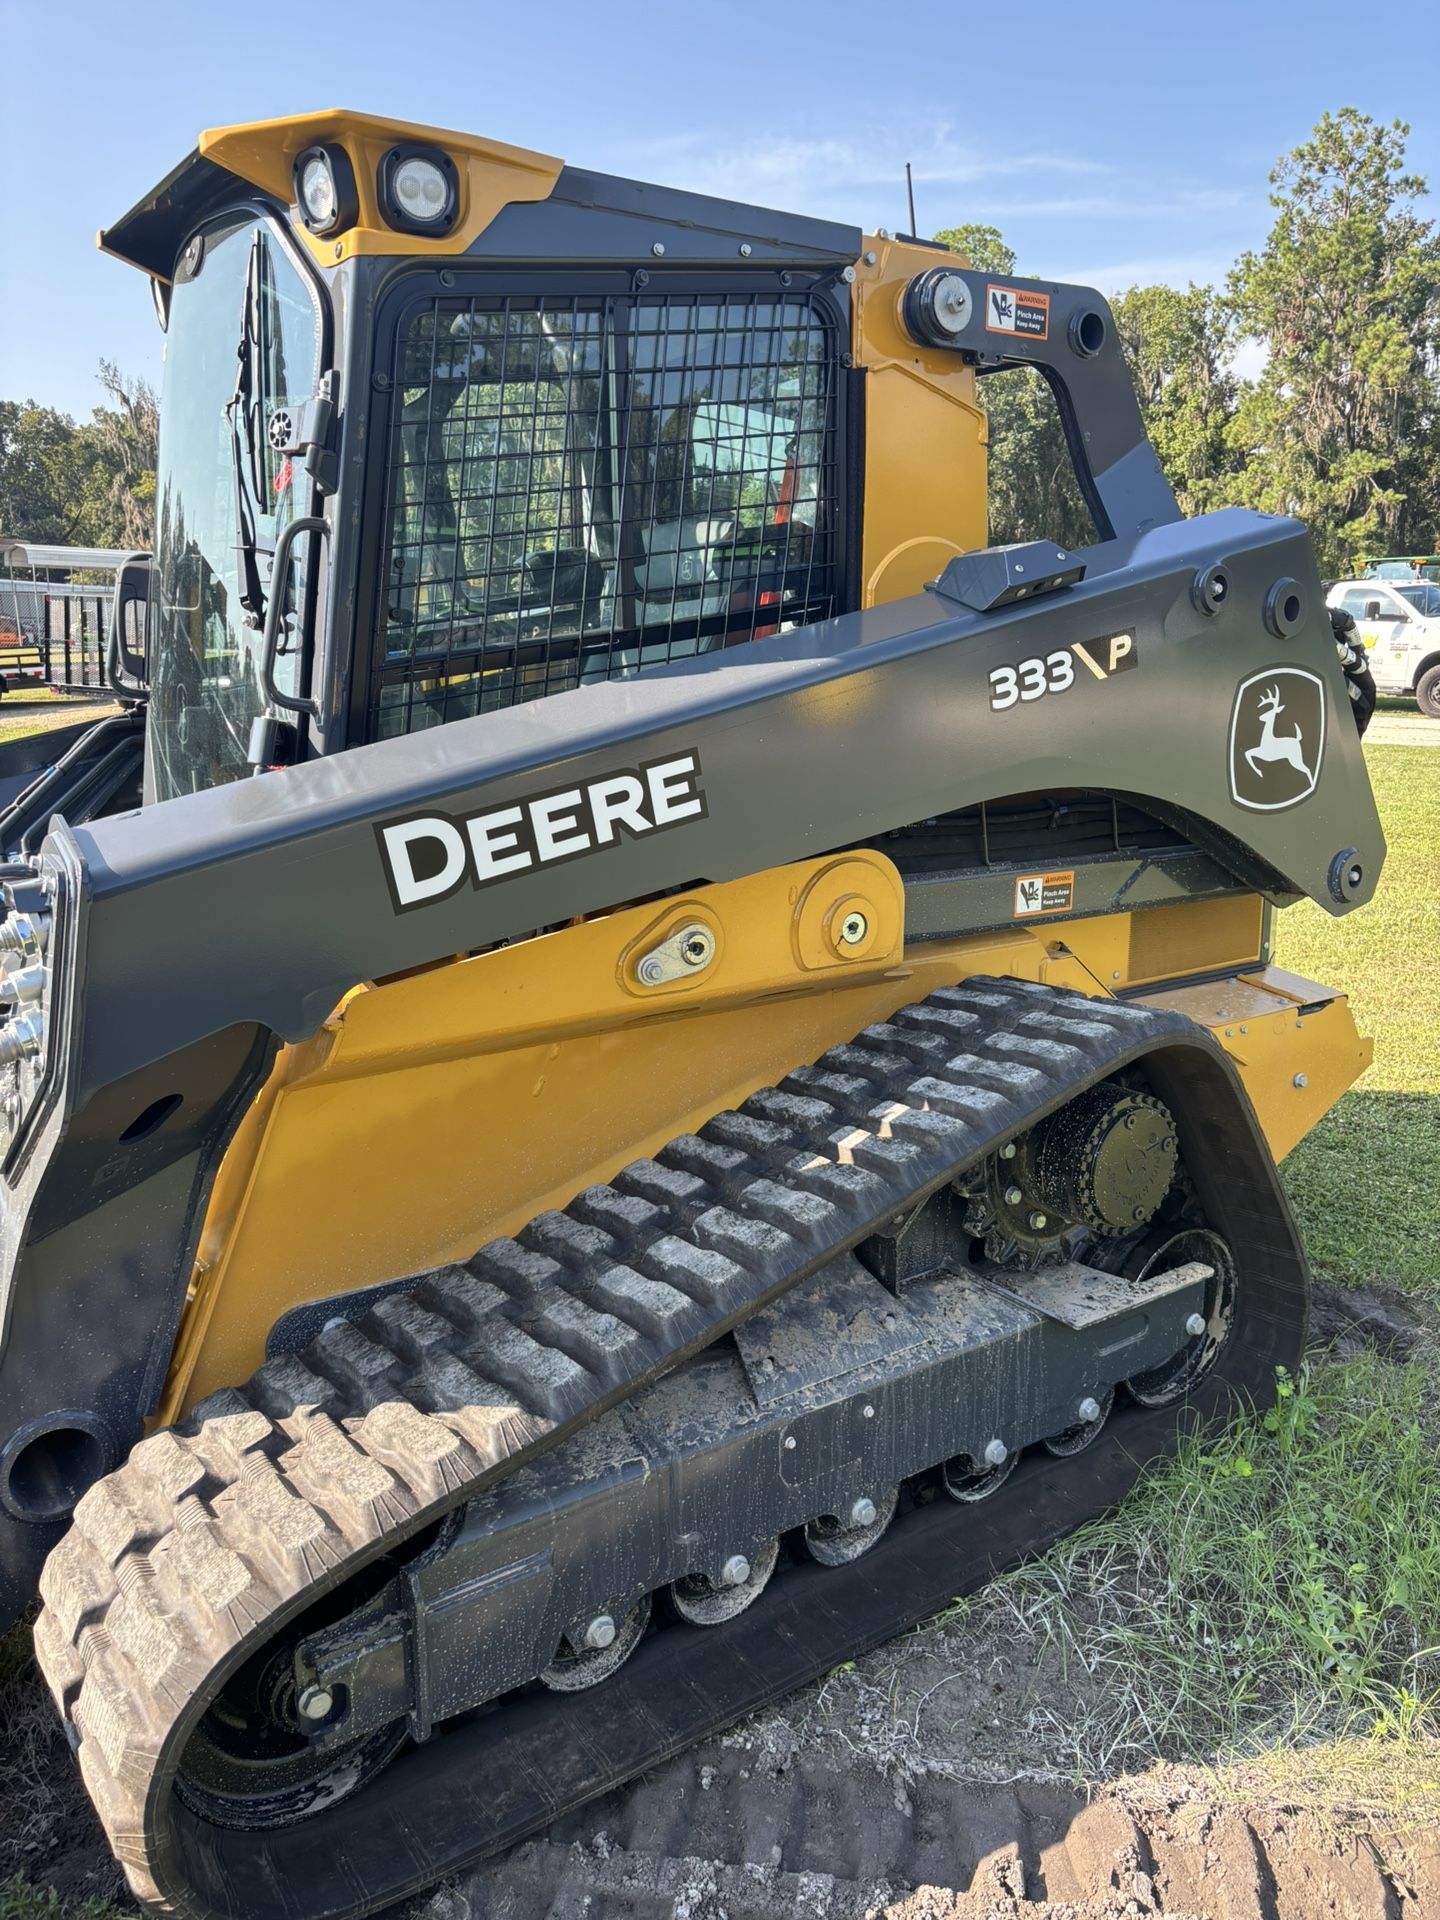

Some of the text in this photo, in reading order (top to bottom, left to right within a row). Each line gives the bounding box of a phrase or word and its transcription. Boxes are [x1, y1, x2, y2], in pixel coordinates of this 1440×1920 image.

[1017, 310, 1045, 321] Pinch Area
[1017, 320, 1041, 330] Keep Away
[989, 650, 1074, 710] 333
[383, 756, 702, 905] DEERE
